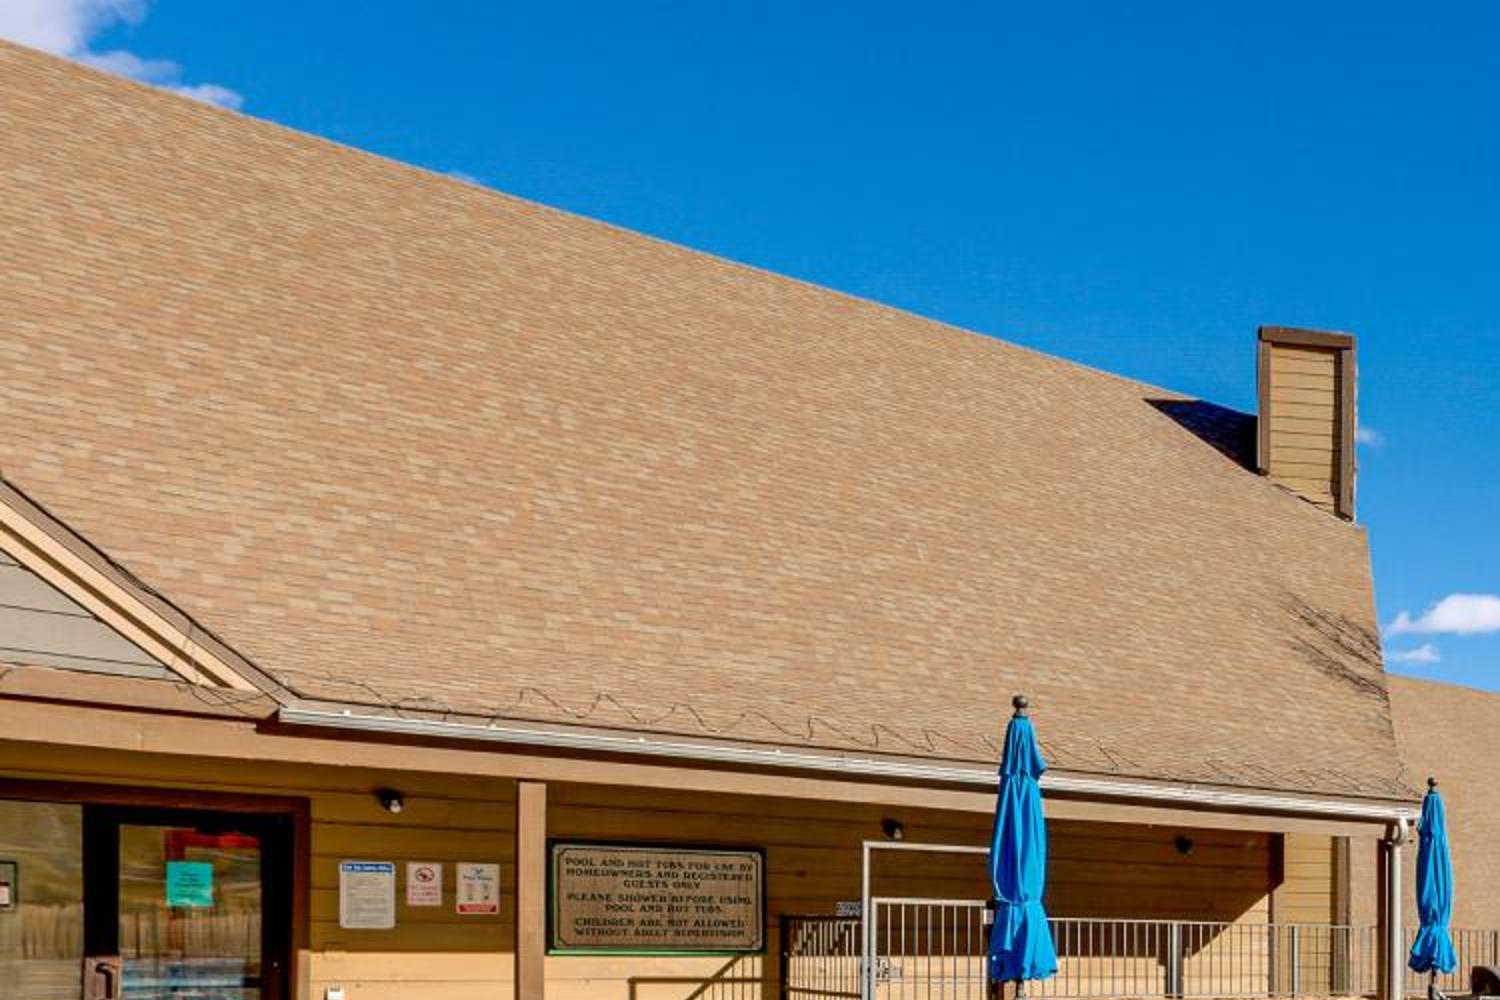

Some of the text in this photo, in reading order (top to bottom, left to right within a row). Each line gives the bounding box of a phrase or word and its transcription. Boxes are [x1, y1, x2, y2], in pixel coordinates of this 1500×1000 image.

[566, 858, 595, 866] POOL
[623, 880, 669, 888] GUESTS
[605, 904, 634, 912] POOL
